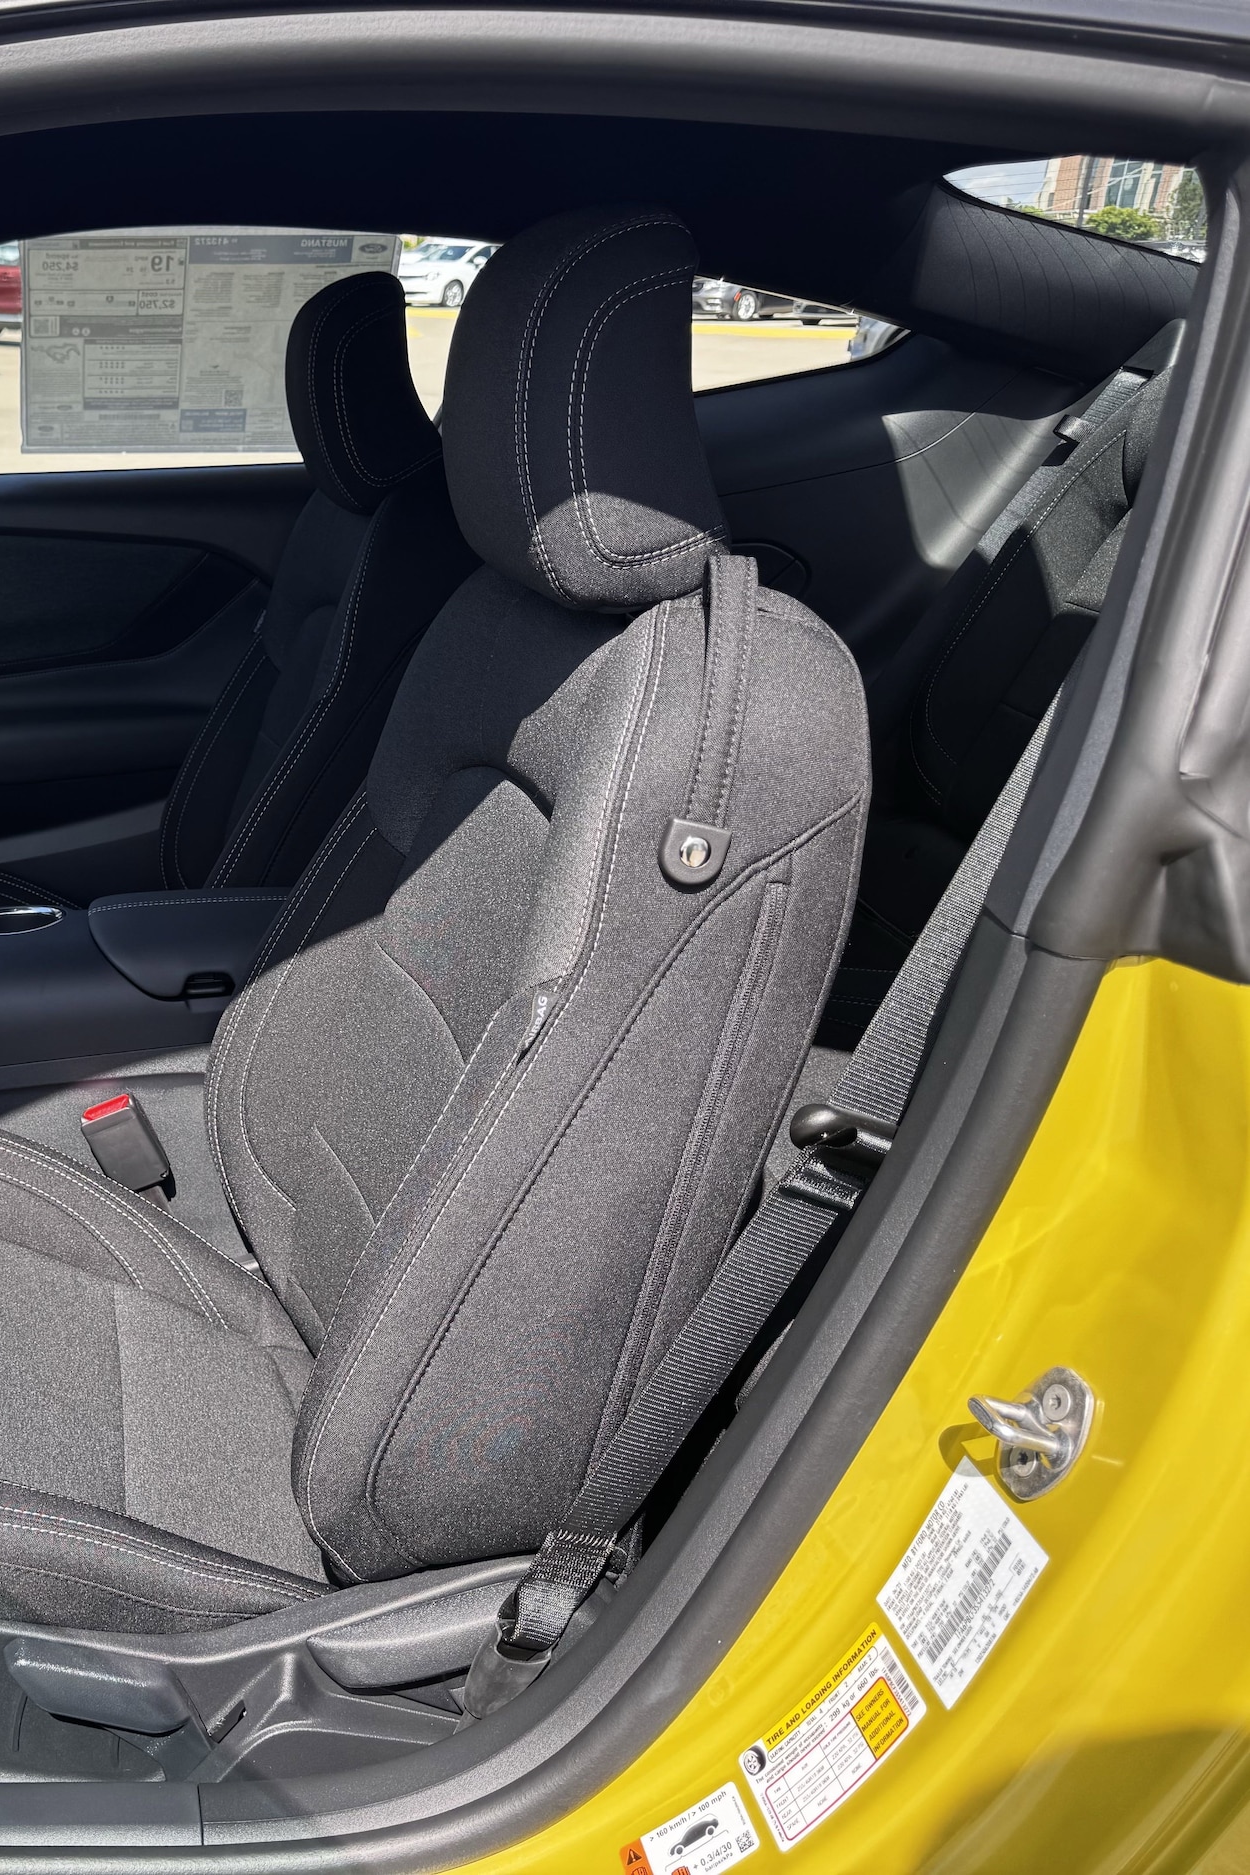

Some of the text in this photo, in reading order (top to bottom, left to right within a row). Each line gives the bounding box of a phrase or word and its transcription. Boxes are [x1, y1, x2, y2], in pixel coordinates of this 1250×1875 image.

[523, 995, 548, 1048] AIRBAG
[910, 1543, 918, 1556] BY
[915, 1528, 927, 1547] FORD
[924, 1507, 940, 1531] MOTOR
[766, 1629, 878, 1747] TIRE AND LOADING INFORMATION
[843, 1680, 849, 1688] 2
[867, 1653, 872, 1661] 2
[828, 1706, 841, 1722] 299
[840, 1697, 850, 1710] kg
[849, 1691, 856, 1701] or
[856, 1676, 869, 1692] 660
[854, 1687, 885, 1722] SEE OWNERS
[860, 1697, 891, 1732] MANUAL FOR
[867, 1708, 896, 1741] ADDITIONAL
[871, 1716, 905, 1753] INFORMATION
[655, 1827, 668, 1838] 160
[667, 1815, 687, 1831] km/h
[697, 1800, 711, 1812] 100
[709, 1790, 727, 1804] mph
[697, 1840, 734, 1867] 0.3/4/30
